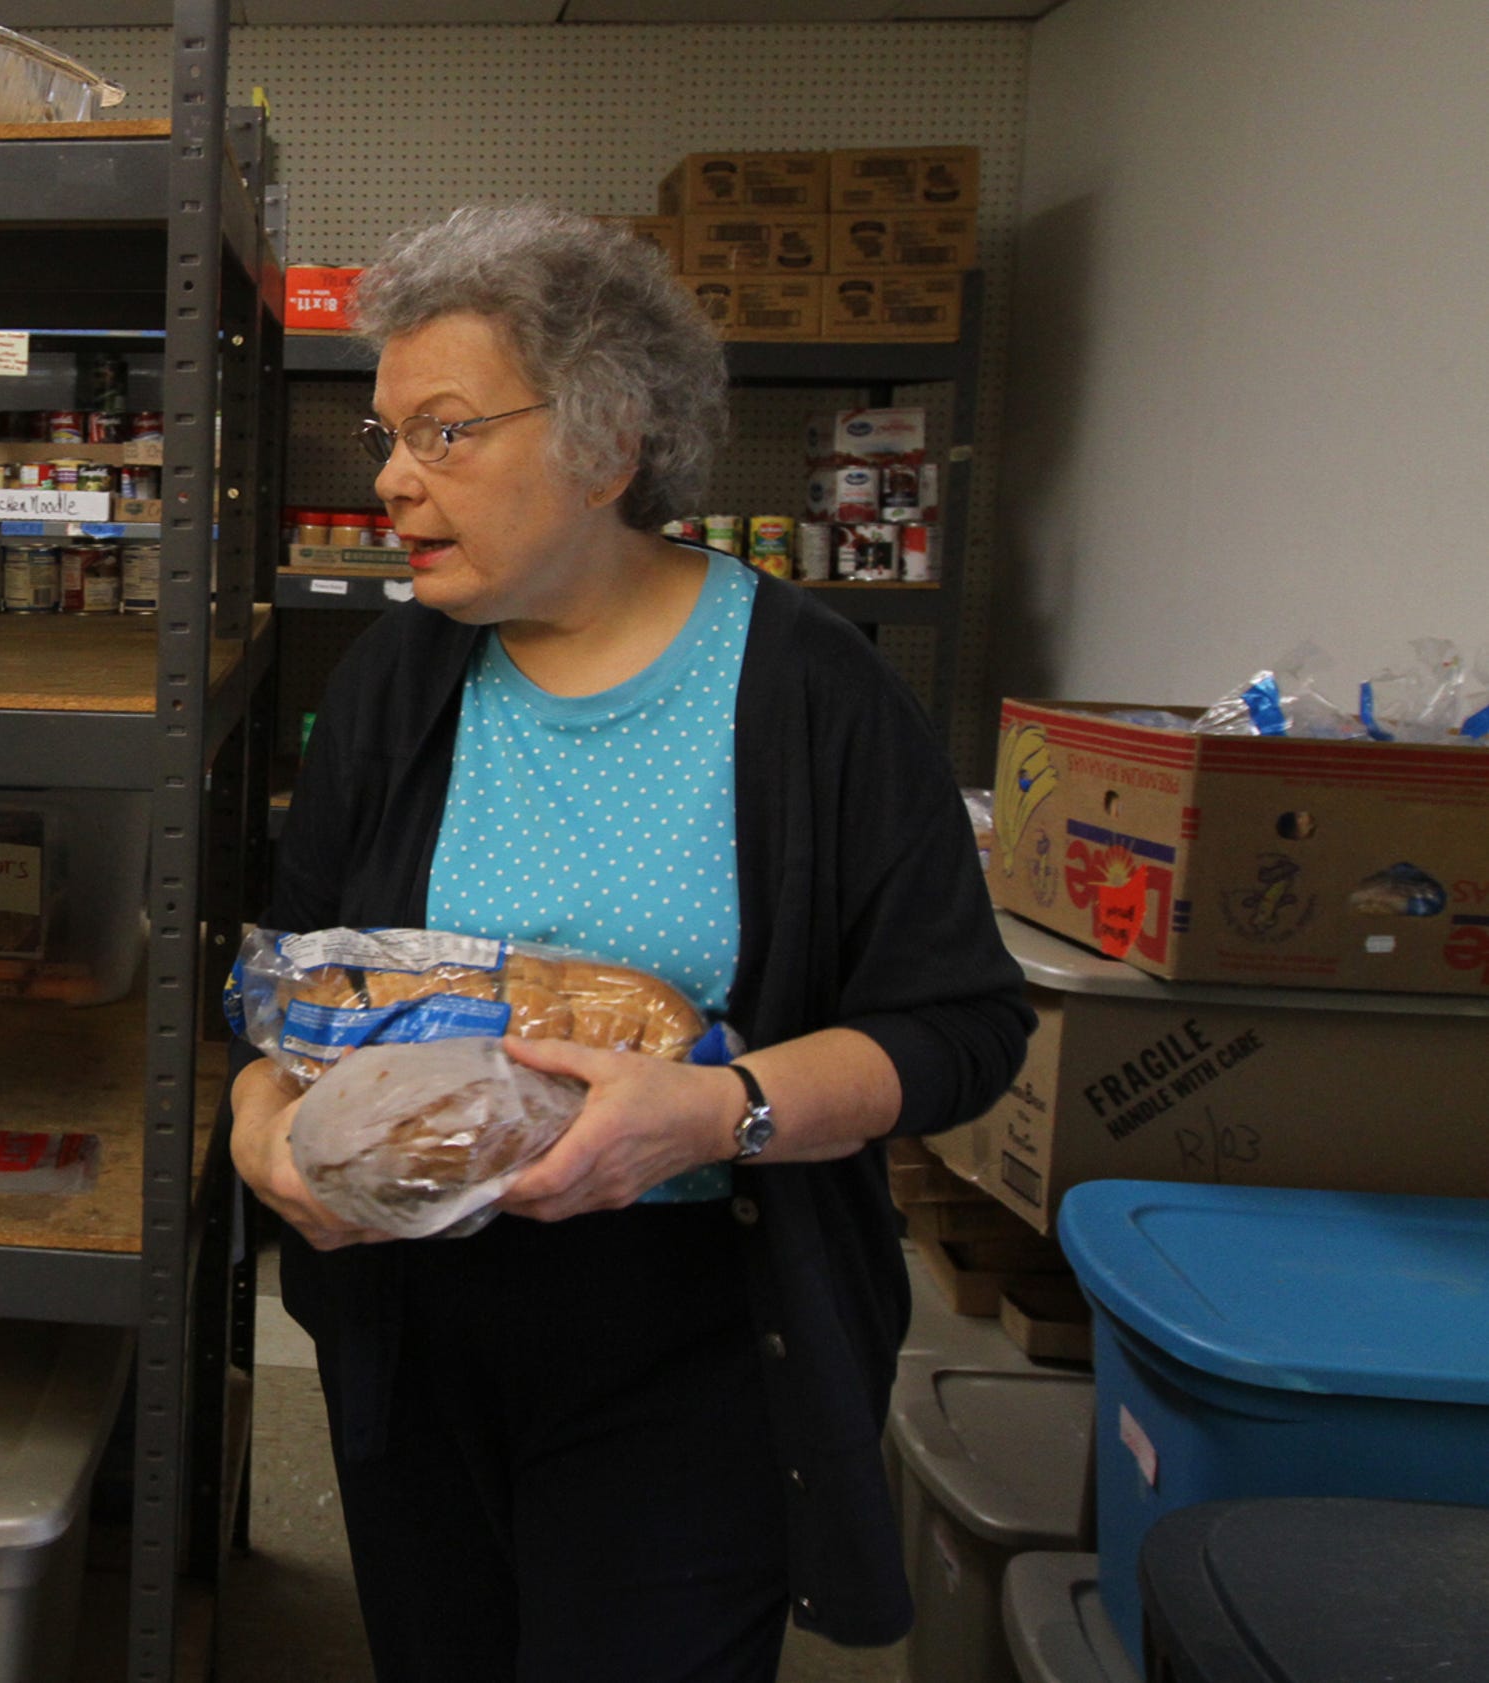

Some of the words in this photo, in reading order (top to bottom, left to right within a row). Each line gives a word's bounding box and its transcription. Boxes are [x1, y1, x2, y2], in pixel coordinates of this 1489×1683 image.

[30, 493, 78, 515] Noodle
[1083, 1018, 1212, 1118] FRAGILE
[1106, 1088, 1175, 1142] HANDLE
[1169, 1058, 1220, 1099] WITH
[1215, 1028, 1264, 1069] CARE
